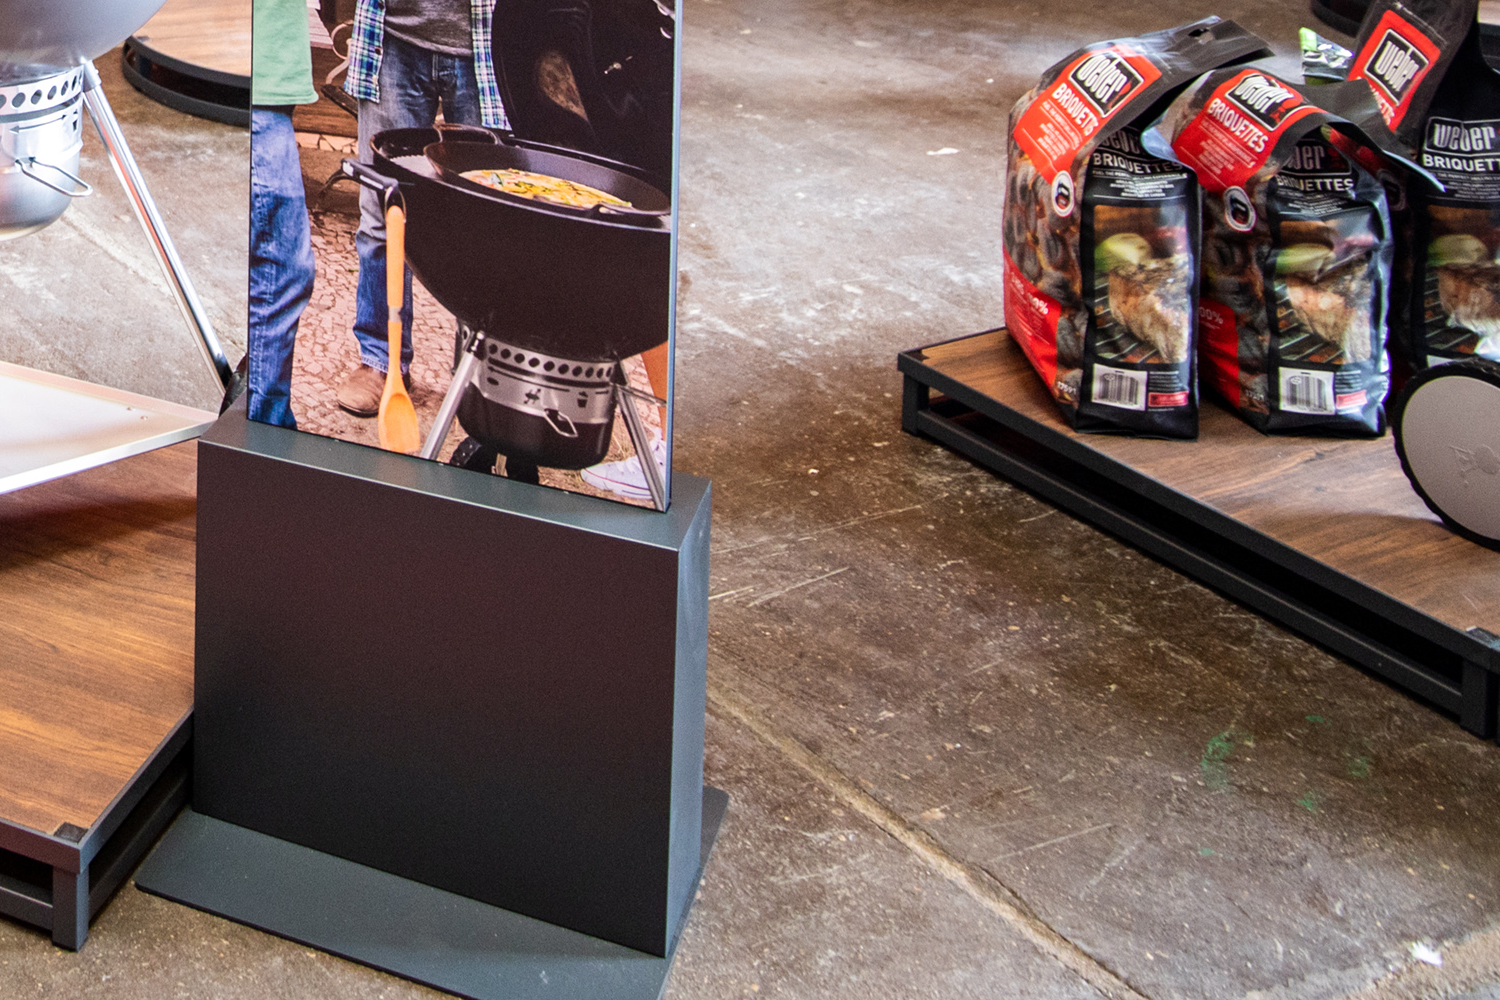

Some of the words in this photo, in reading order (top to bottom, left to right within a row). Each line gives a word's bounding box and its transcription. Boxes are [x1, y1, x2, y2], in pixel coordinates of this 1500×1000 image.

[1076, 54, 1127, 104] weber
[1374, 41, 1419, 92] weber
[1207, 98, 1269, 153] BRIQUETTES
[1433, 123, 1496, 151] weber
